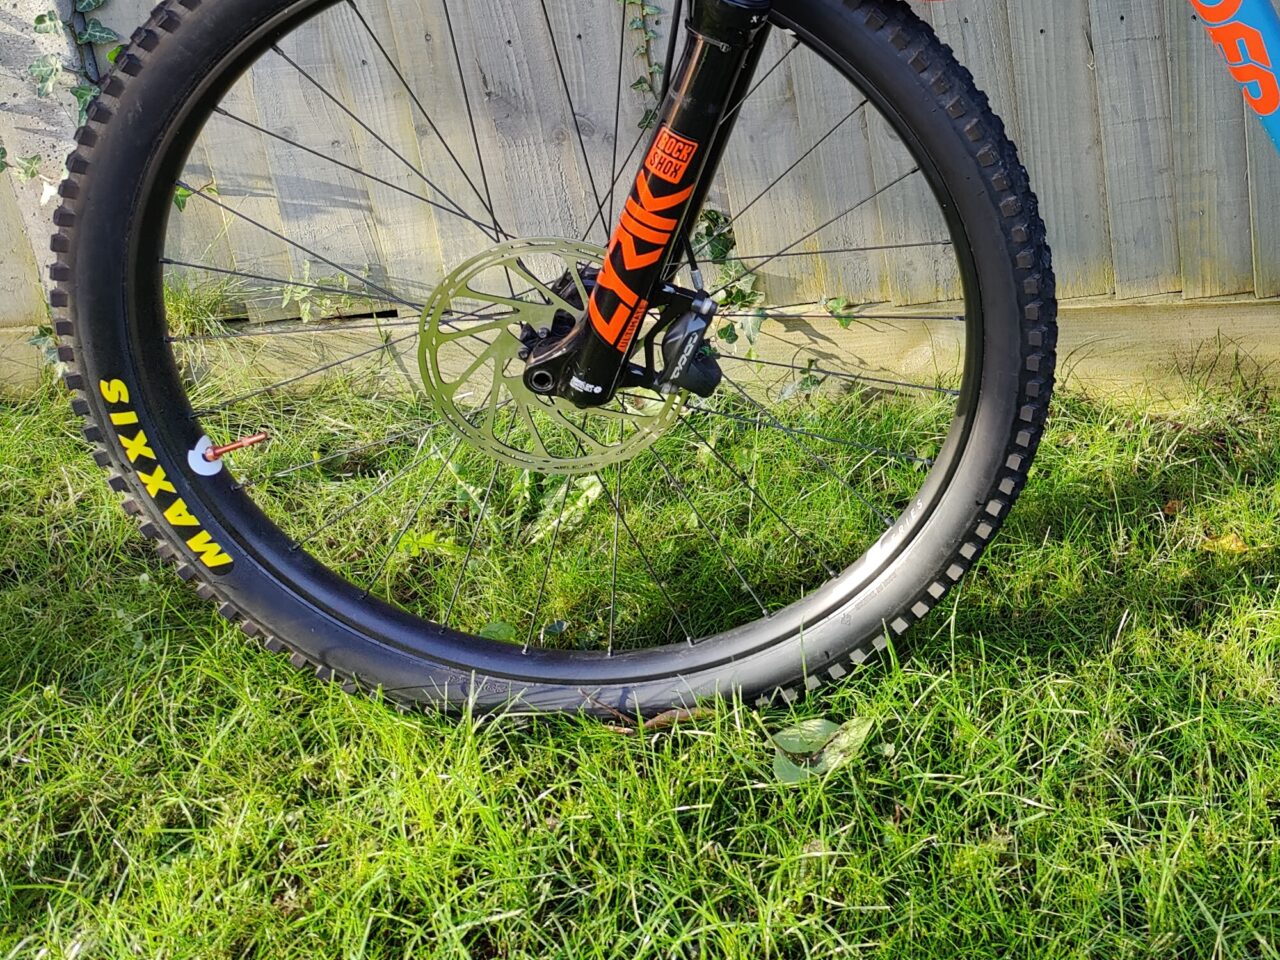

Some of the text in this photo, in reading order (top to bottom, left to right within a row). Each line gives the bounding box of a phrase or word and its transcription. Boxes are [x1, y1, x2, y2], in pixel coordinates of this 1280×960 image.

[649, 151, 683, 180] SHOX
[655, 131, 694, 163] ROCK
[617, 300, 648, 351] ULTIMATE
[100, 378, 234, 568] MAXXIS
